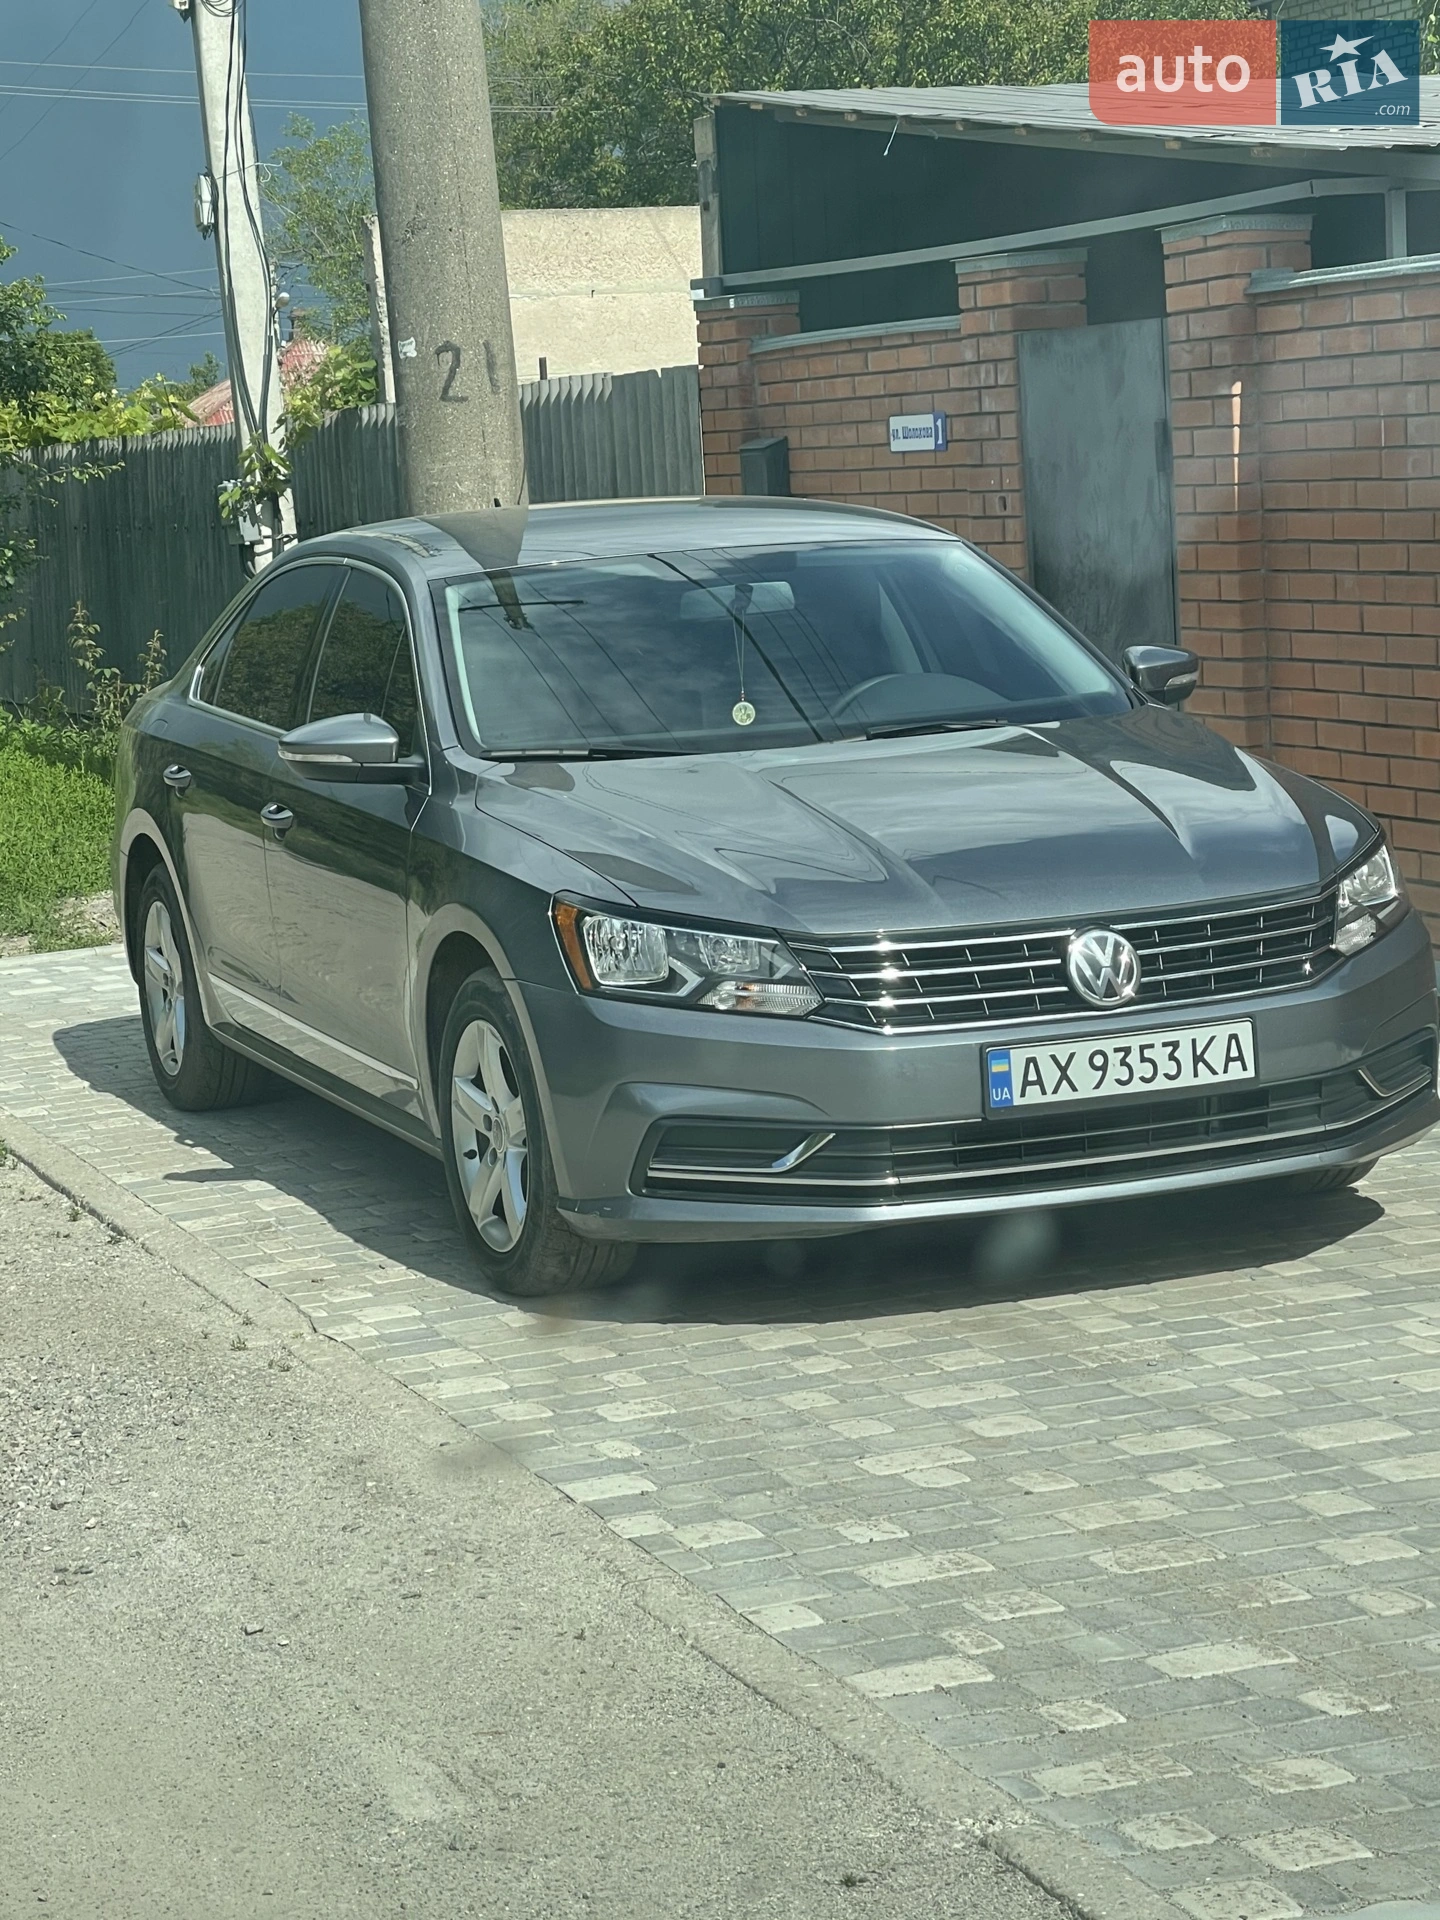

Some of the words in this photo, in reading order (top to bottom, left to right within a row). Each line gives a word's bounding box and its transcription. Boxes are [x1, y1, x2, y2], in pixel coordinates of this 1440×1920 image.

[891, 428, 901, 441] ул.
[902, 426, 933, 439] Шолохова
[936, 418, 943, 444] 1
[1019, 1051, 1079, 1099] AX
[1088, 1039, 1183, 1090] 9353
[1191, 1032, 1249, 1079] KA
[992, 1087, 1011, 1101] UA
